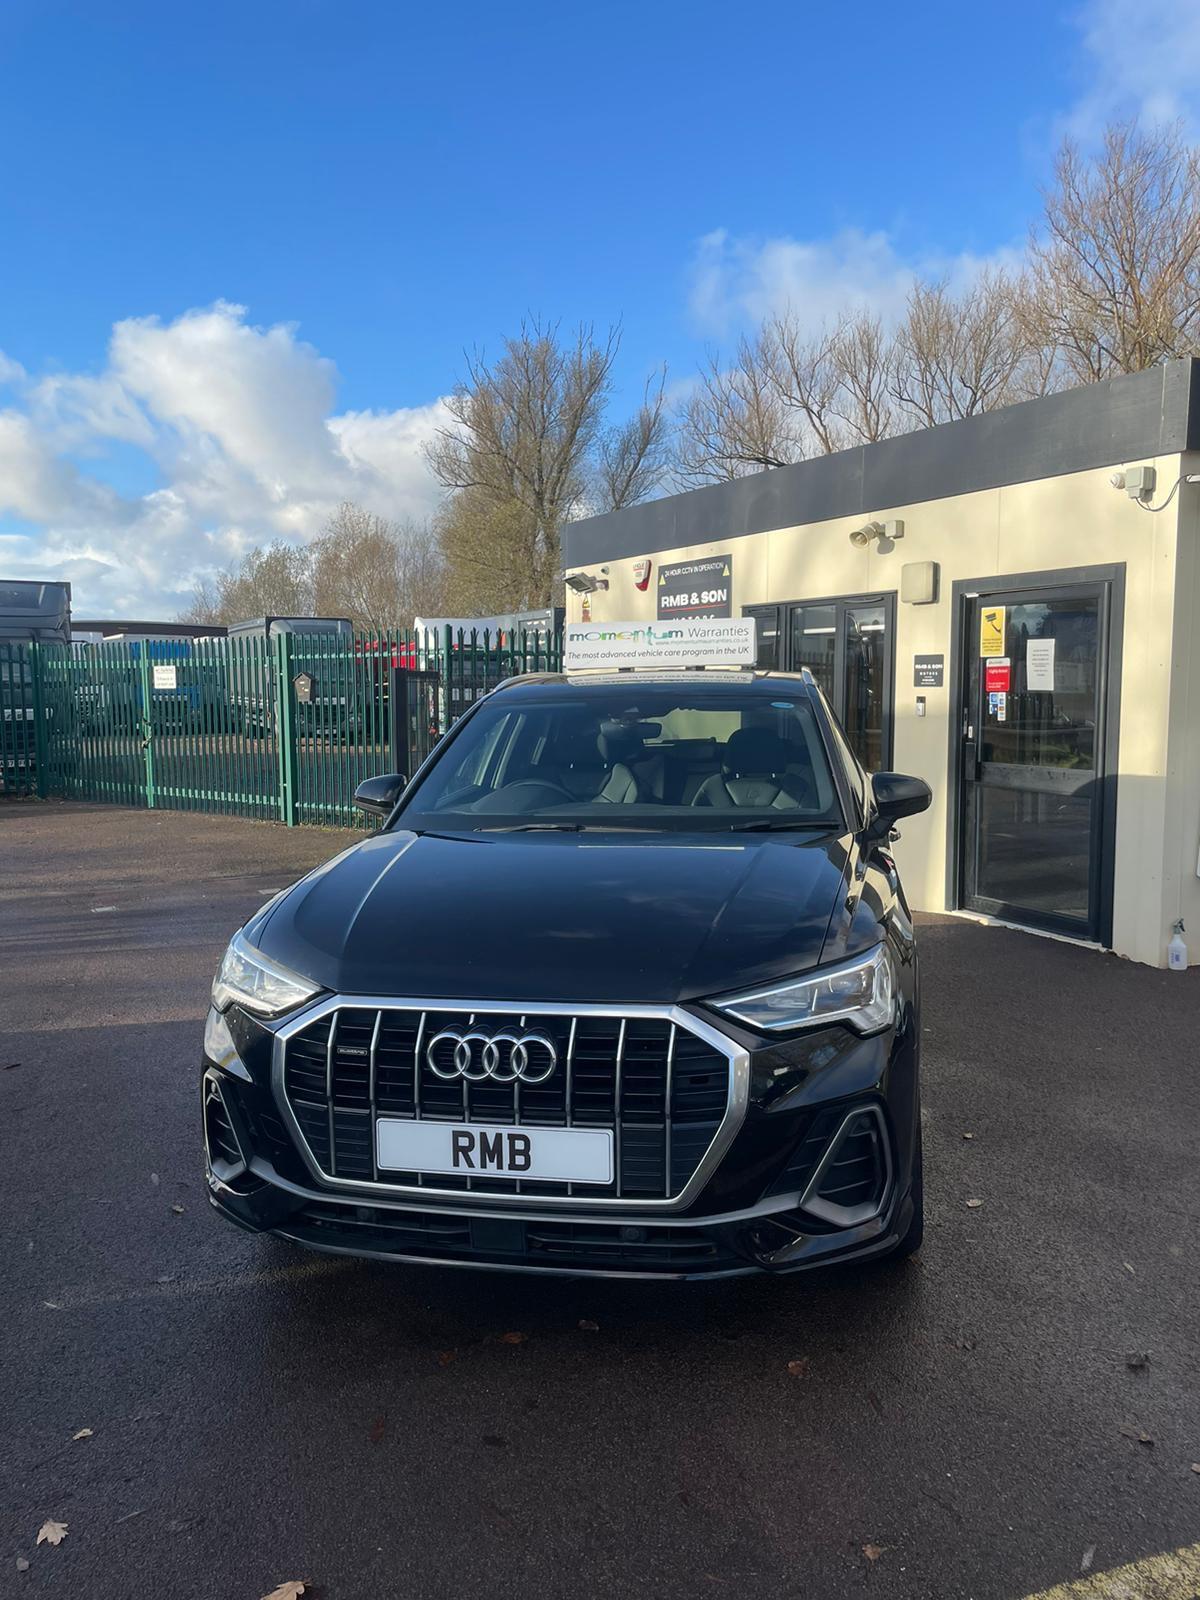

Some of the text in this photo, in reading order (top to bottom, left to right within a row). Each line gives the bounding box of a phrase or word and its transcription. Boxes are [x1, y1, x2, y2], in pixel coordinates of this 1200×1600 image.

[670, 568, 682, 577] HOUR
[682, 566, 693, 574] CCTV
[699, 562, 724, 572] OPERATION
[661, 589, 727, 608] RMB & SON
[688, 626, 749, 638] Warranties
[568, 651, 580, 659] The
[600, 650, 637, 659] advanced
[637, 649, 663, 658] vehicle
[681, 648, 715, 657] program
[724, 647, 737, 655] the
[738, 646, 749, 654] UK
[451, 1130, 532, 1172] RMB
